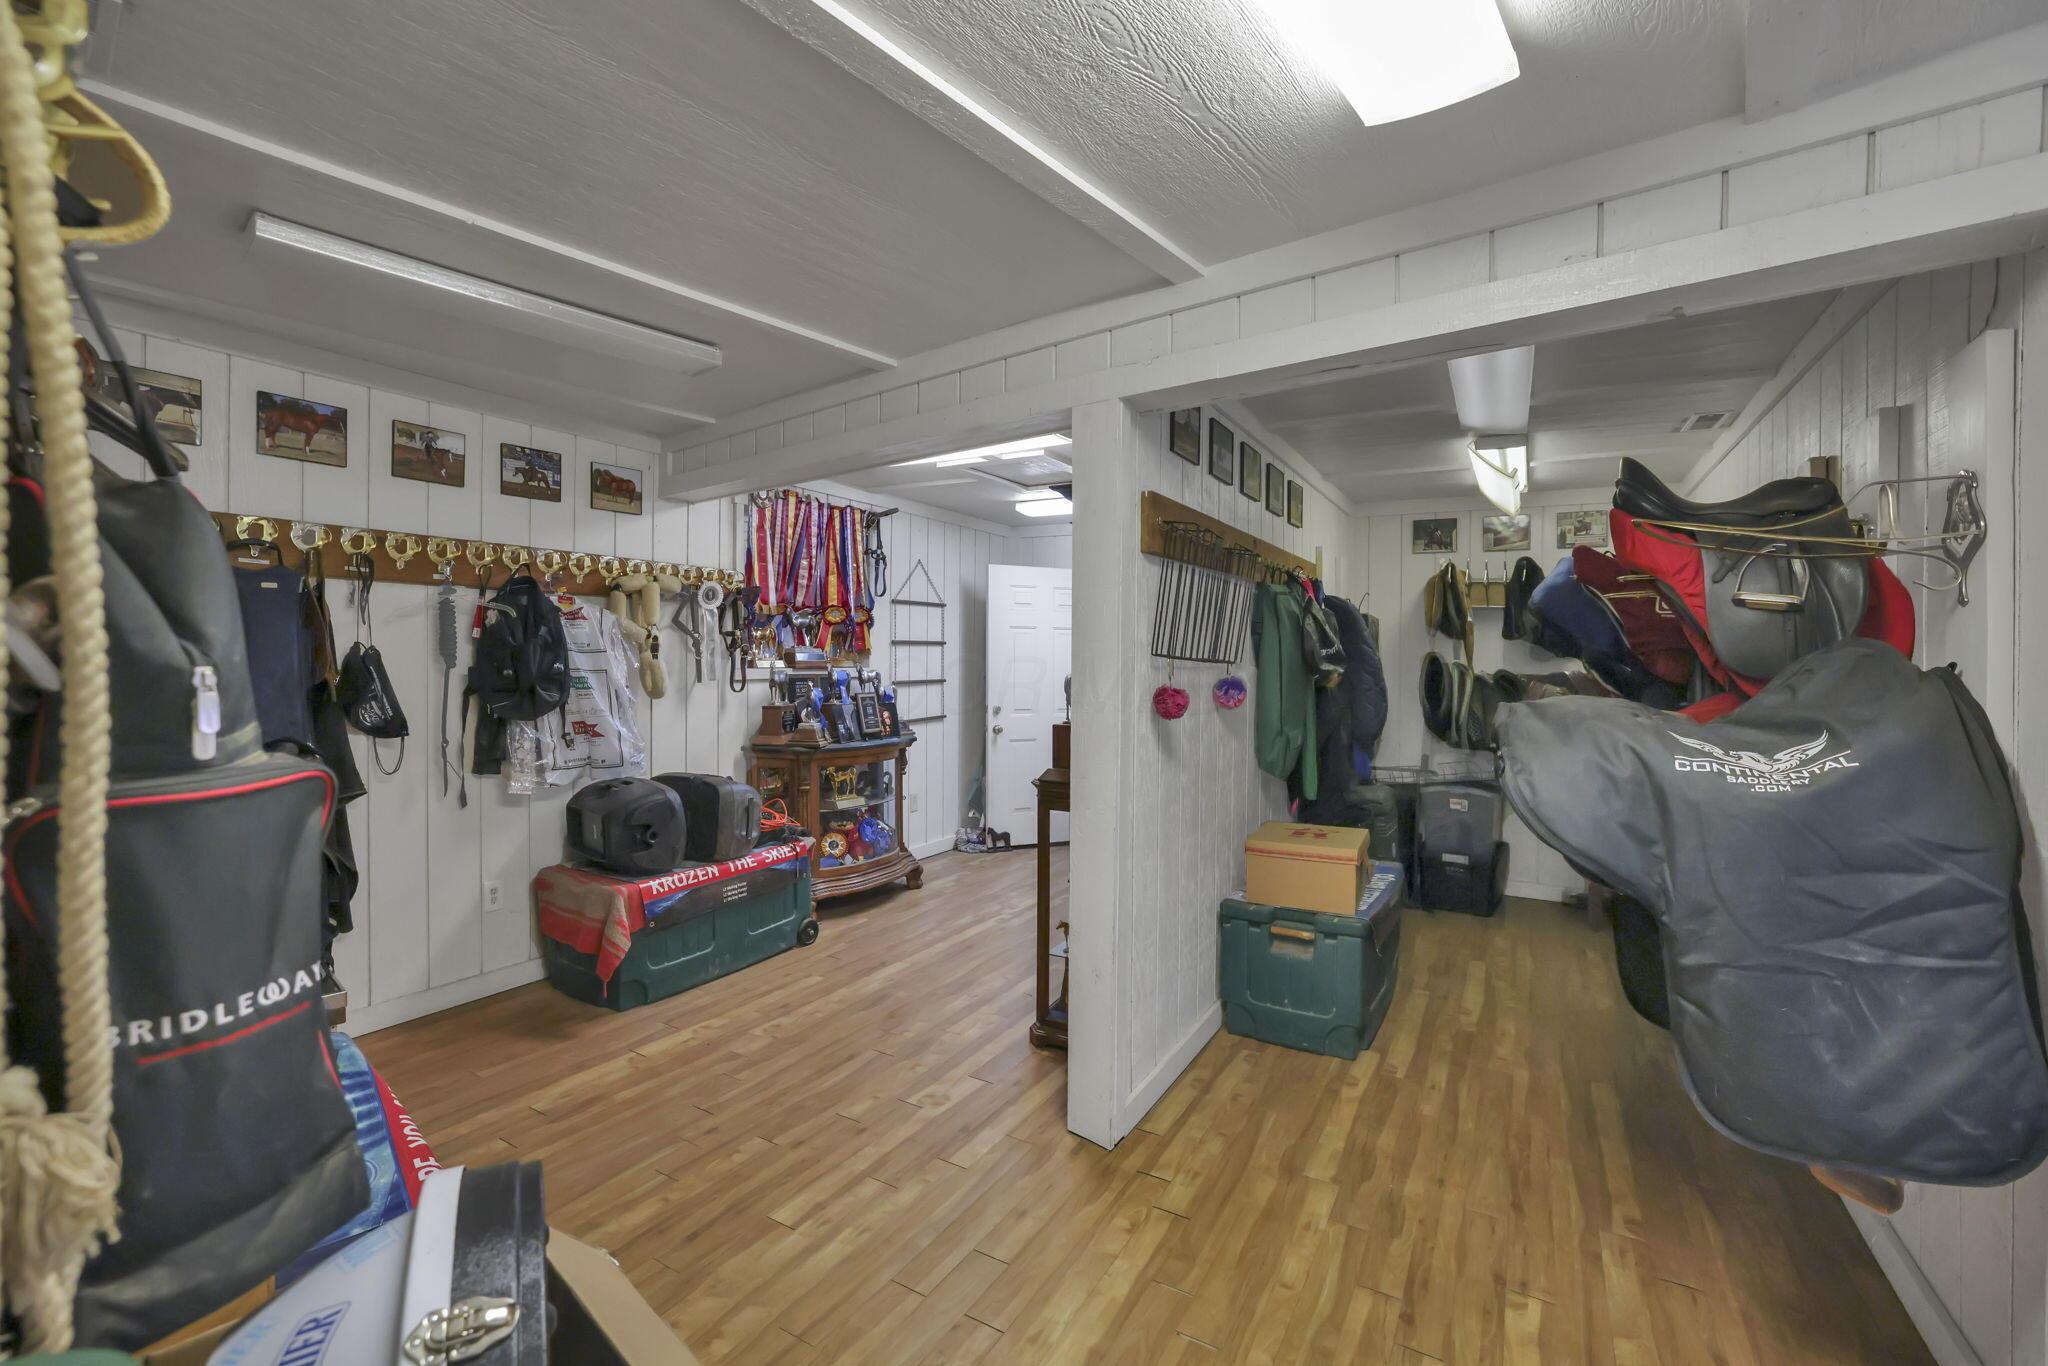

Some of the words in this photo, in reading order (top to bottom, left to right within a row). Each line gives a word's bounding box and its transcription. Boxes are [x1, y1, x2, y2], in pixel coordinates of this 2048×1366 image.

[1674, 757, 1860, 781] CONTINENTAL
[1726, 775, 1810, 785] SADDLERY
[1750, 785, 1791, 793] .COM
[728, 857, 758, 872] THE
